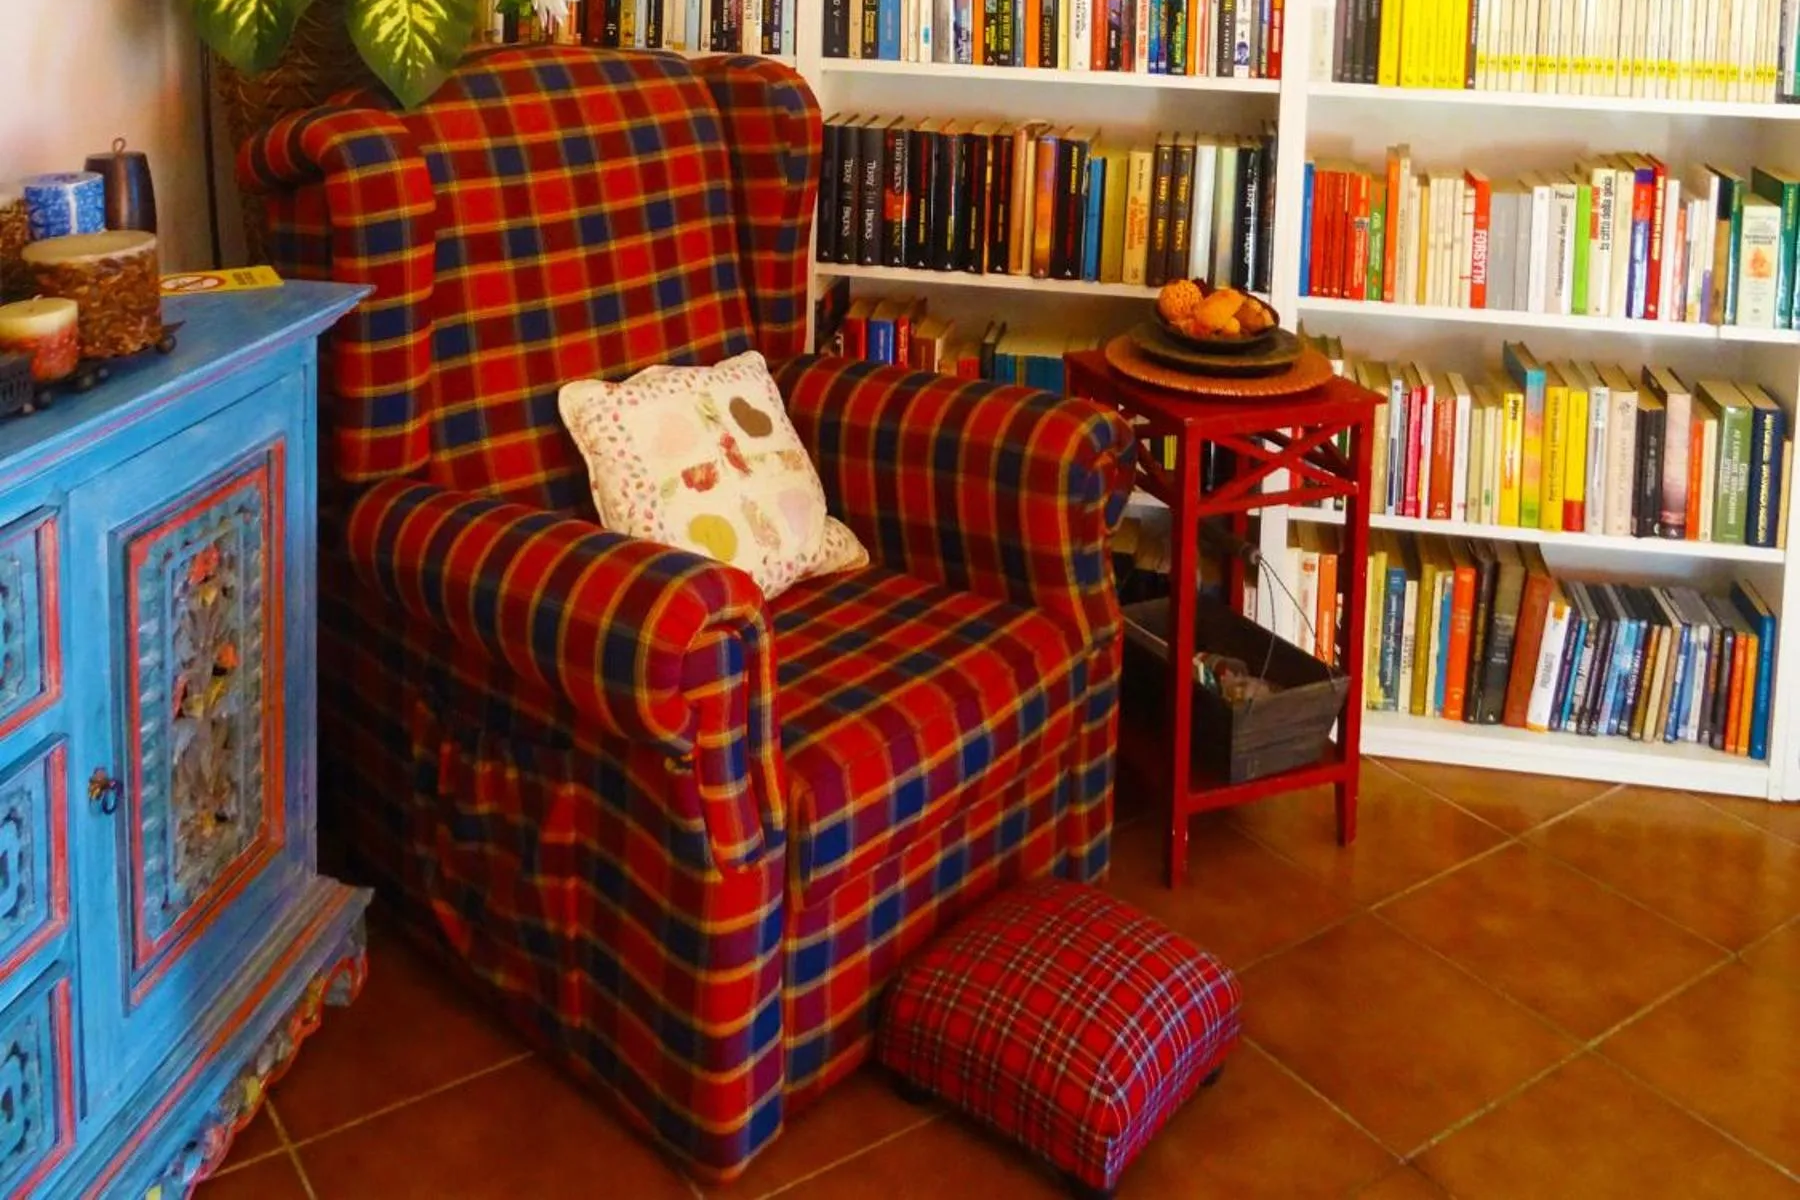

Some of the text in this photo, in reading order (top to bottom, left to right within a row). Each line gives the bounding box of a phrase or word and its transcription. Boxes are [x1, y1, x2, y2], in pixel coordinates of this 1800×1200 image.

[1601, 200, 1612, 221] della
[1600, 221, 1610, 241] città
[1472, 229, 1488, 285] FORSYTH
